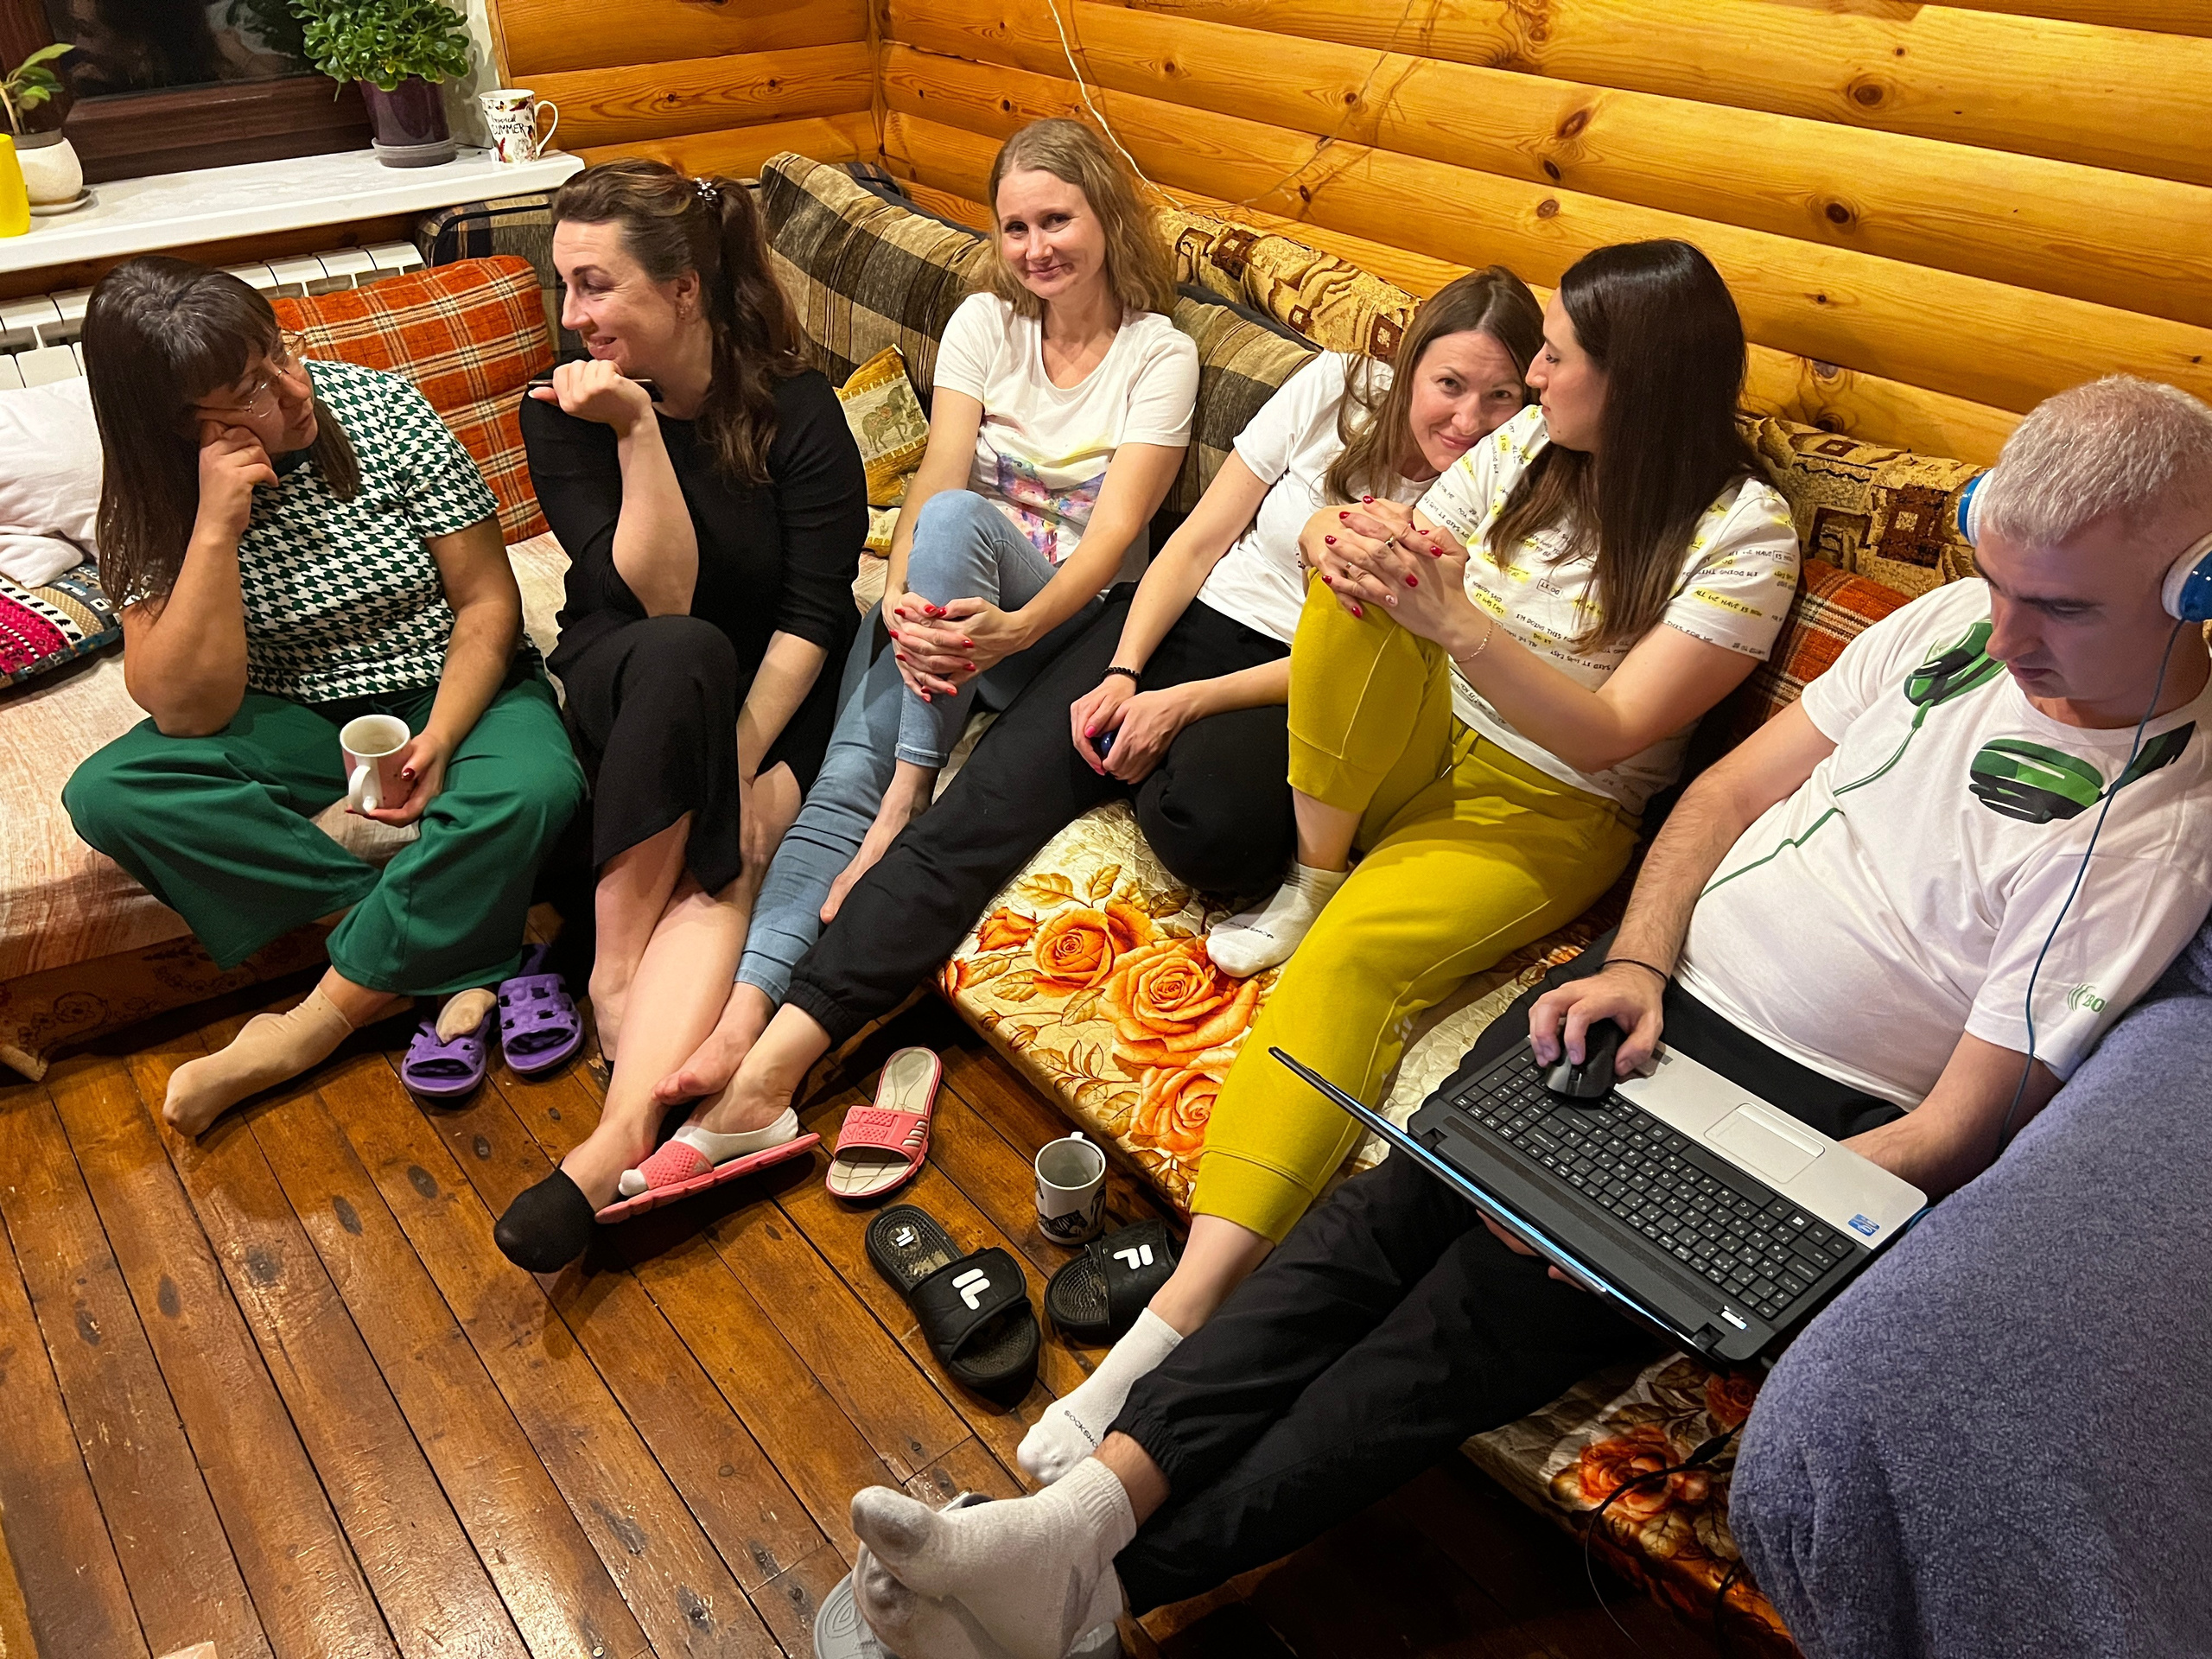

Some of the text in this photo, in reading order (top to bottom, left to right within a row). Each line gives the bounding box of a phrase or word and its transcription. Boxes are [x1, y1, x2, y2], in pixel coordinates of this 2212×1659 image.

[492, 123, 527, 137] SUMMER
[1471, 581, 1503, 603] NOBODY SAID
[1694, 589, 1706, 598] ALL
[1720, 599, 1739, 609] HAVE
[1526, 619, 1546, 632] DOING
[1547, 628, 1562, 639] THIS
[1549, 650, 1565, 660] EASY
[1592, 662, 1611, 671] SAID
[1064, 1410, 1099, 1448] SOCKSHO
